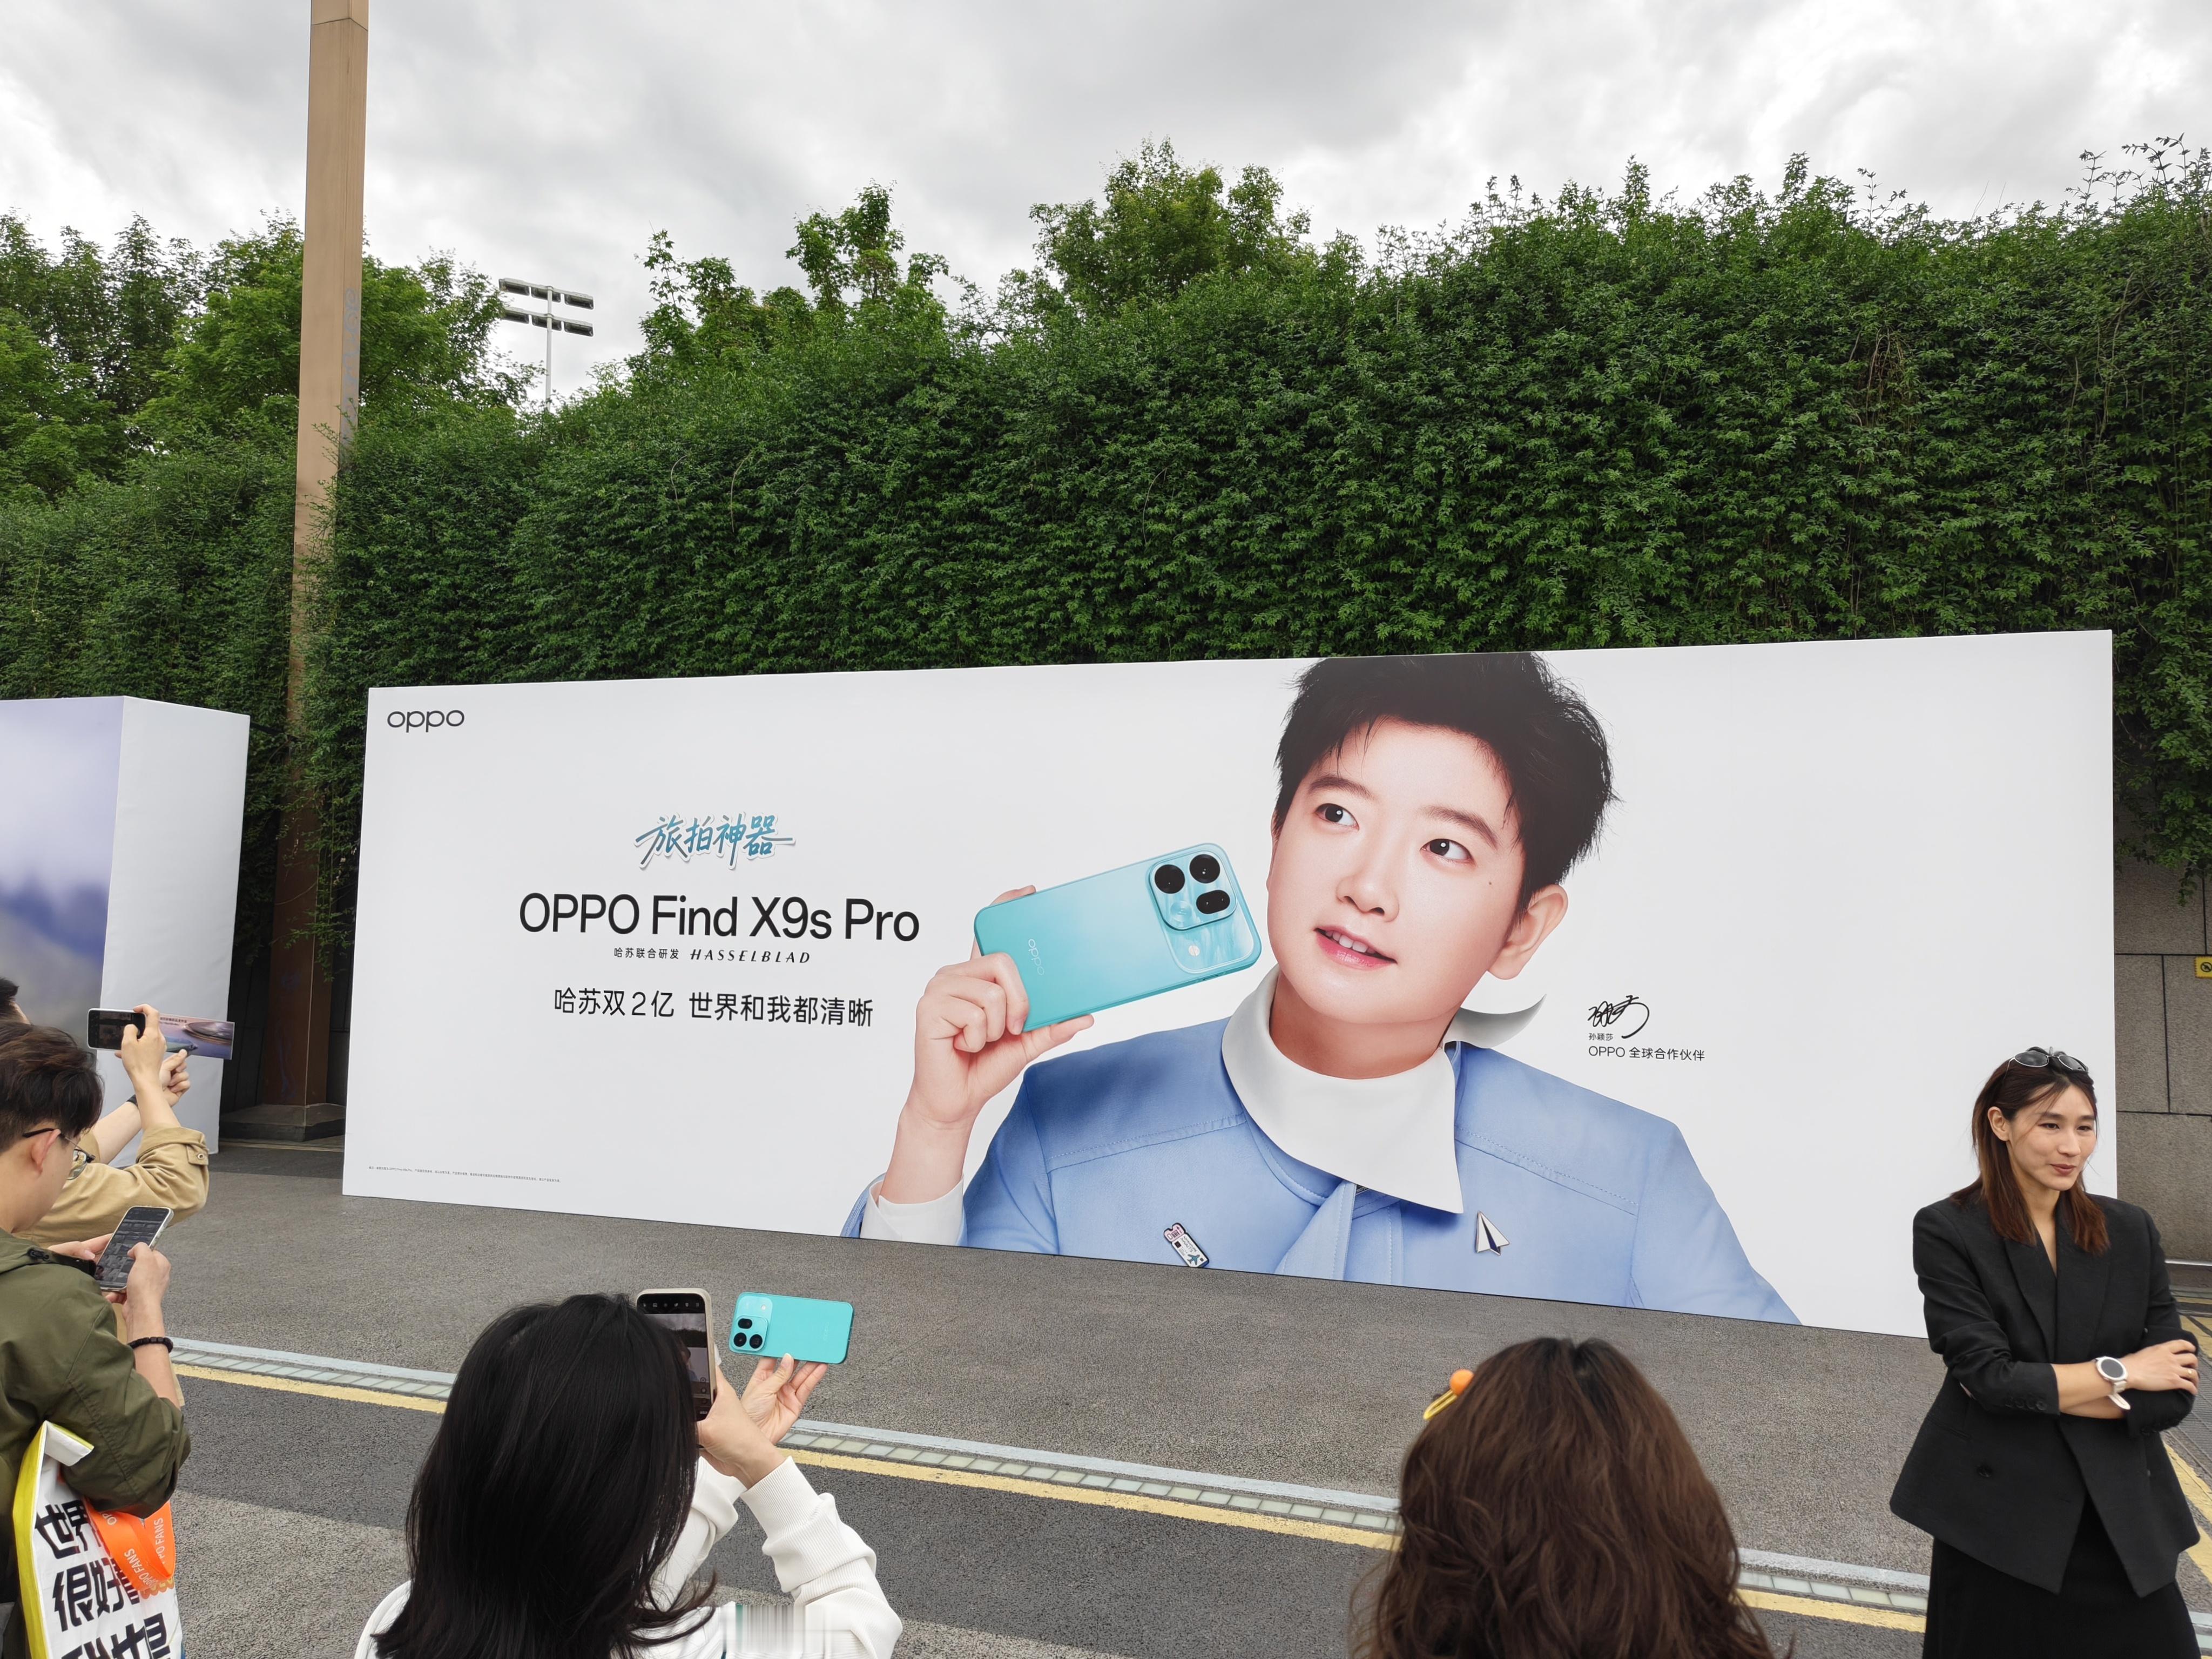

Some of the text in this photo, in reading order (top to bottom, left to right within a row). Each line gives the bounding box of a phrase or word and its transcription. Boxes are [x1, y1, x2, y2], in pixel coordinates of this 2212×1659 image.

[387, 710, 465, 733] oppo
[636, 813, 794, 868] 旅拍神器
[520, 892, 920, 942] OPPO Find X9s Pro
[613, 947, 810, 963] 哈苏联合研发 HASSELBLAD
[689, 992, 873, 1027] 世界和我都清晰
[1588, 1033, 1614, 1041] 孙颖莎
[1588, 1046, 1705, 1062] OPPO 全球合作伙伴
[154, 1518, 164, 1545] FANS
[124, 1548, 144, 1574] FANS
